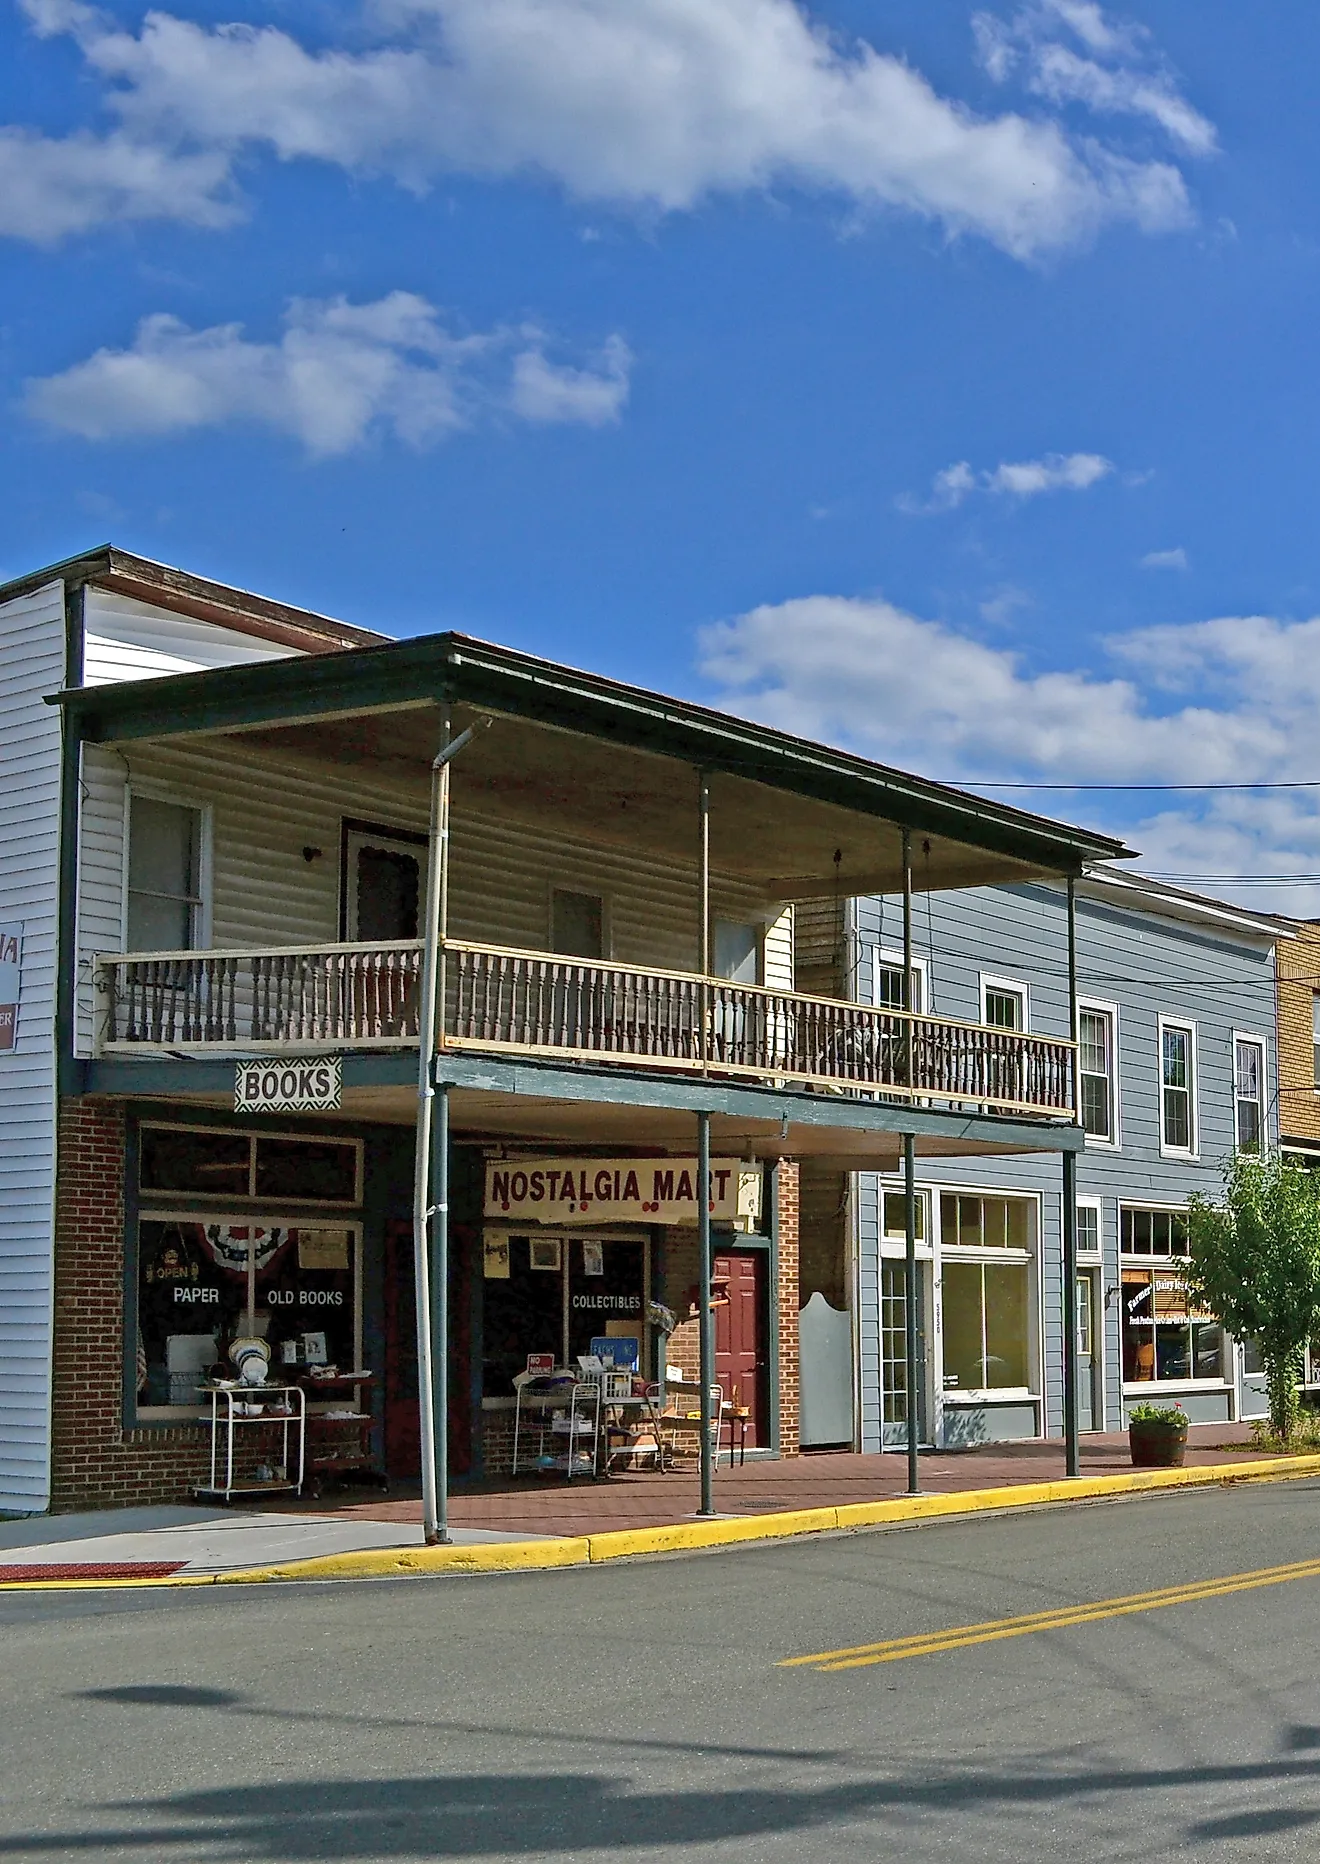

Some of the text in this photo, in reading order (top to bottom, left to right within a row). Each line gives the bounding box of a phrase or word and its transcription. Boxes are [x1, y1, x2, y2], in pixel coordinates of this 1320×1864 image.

[244, 1068, 330, 1100] BOOKS
[492, 1170, 640, 1201] NOSTALGIA
[156, 1267, 188, 1278] OPEN
[173, 1287, 219, 1303] PAPER
[267, 1290, 343, 1305] OLD BOOKS
[572, 1295, 641, 1309] COLLECTIBLES
[530, 1356, 541, 1365] NO
